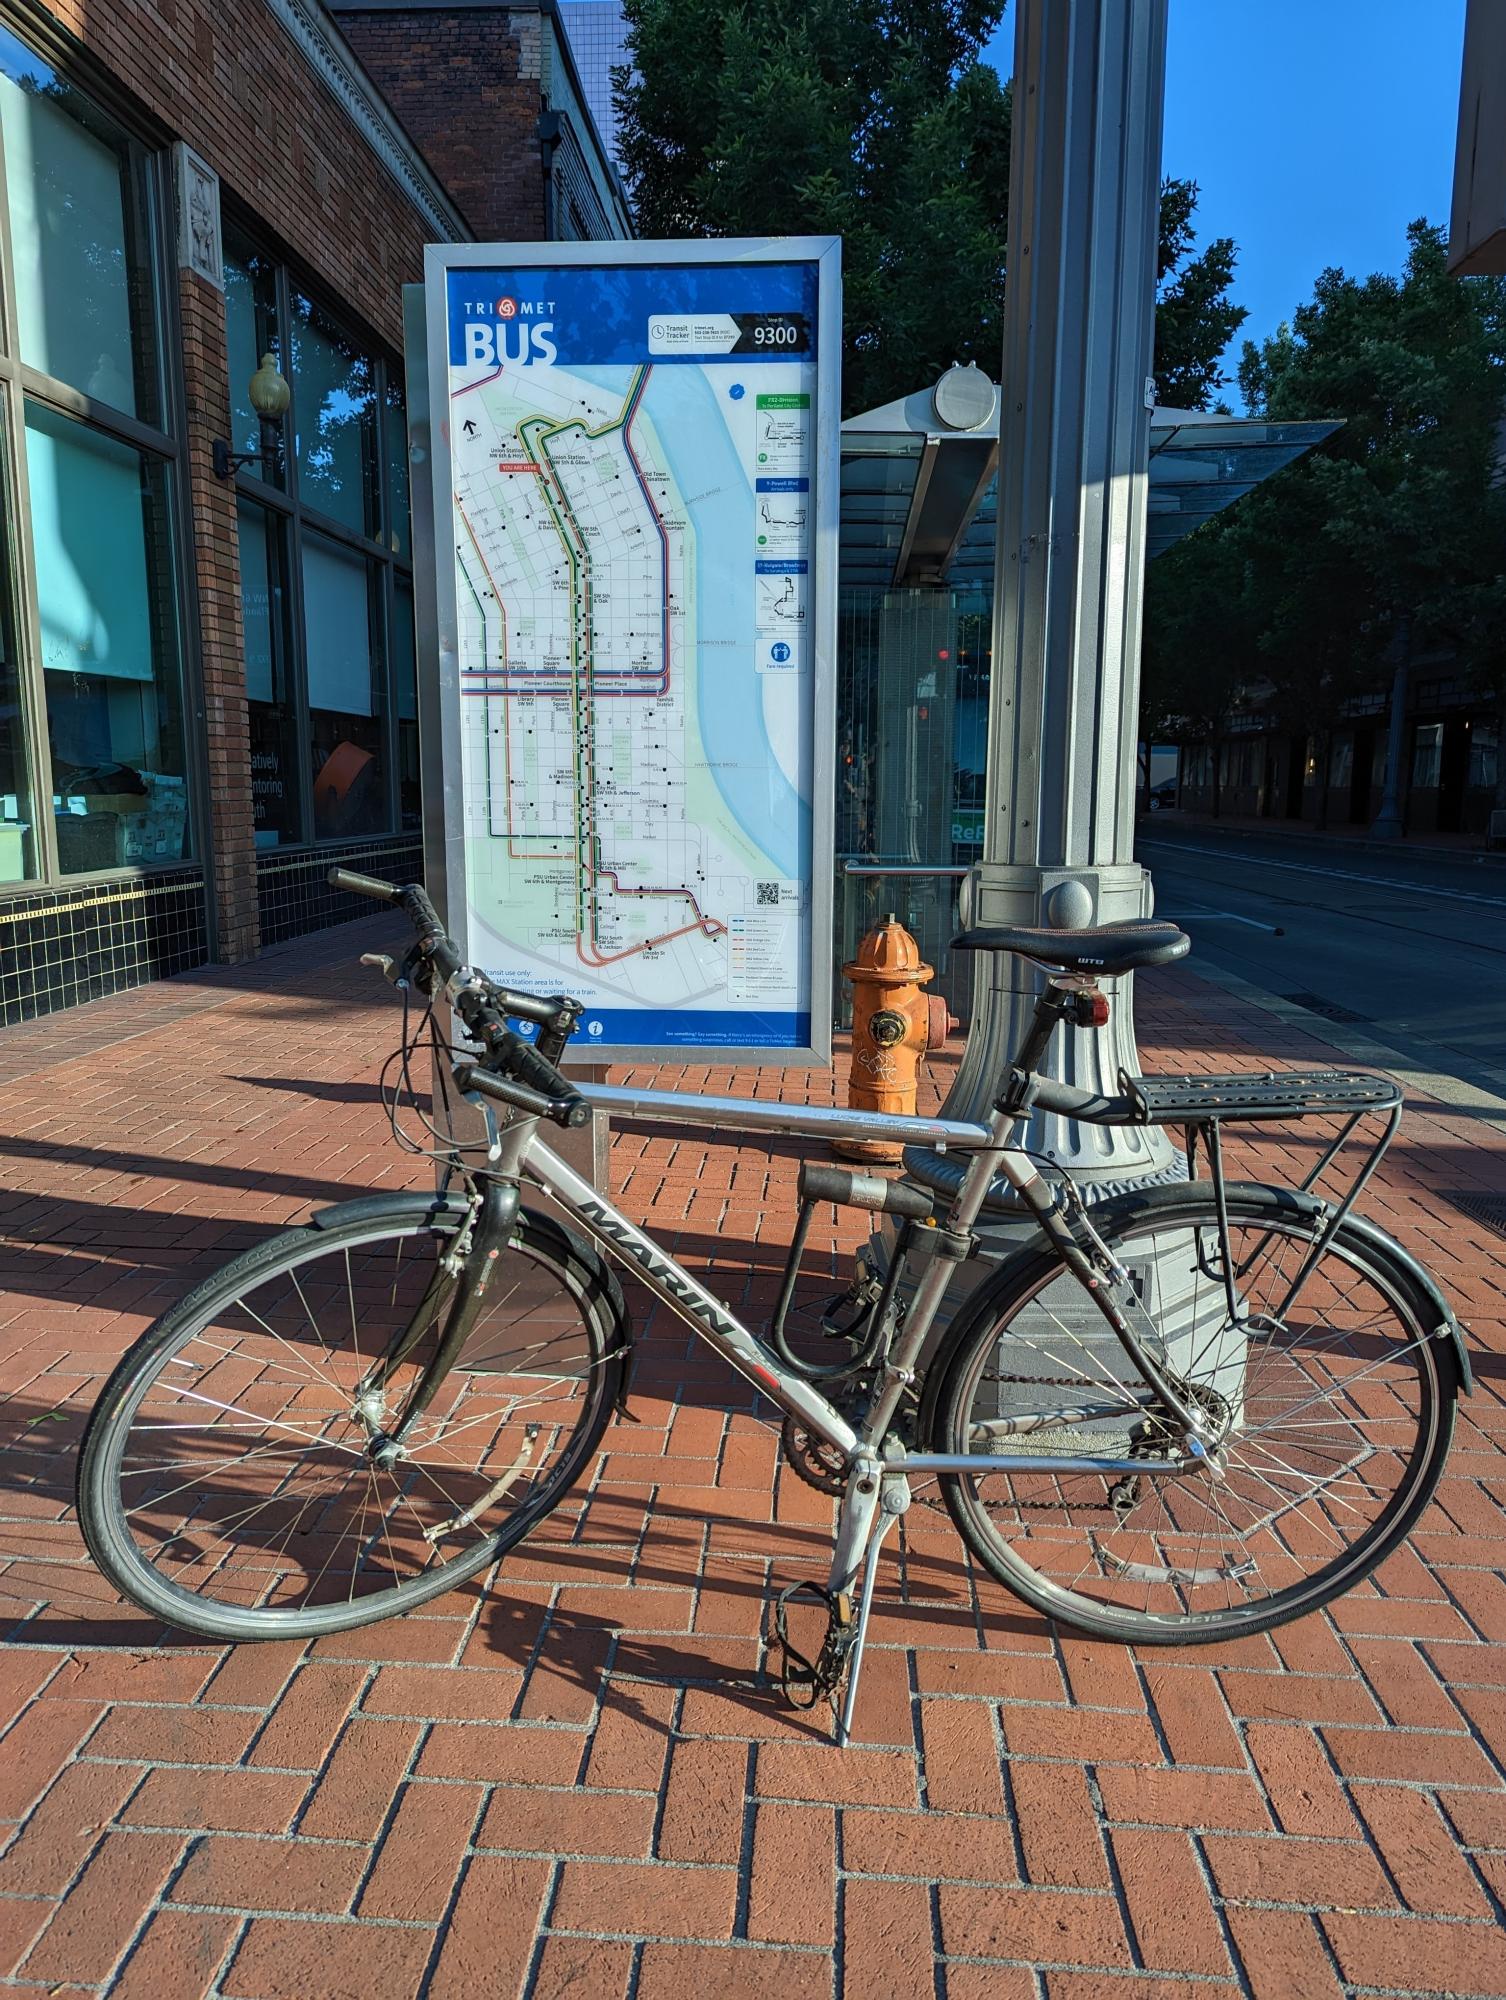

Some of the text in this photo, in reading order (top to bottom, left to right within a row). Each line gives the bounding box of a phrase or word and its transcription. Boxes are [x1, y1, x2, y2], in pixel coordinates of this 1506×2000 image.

[464, 303, 555, 314] TRI MET
[754, 327, 797, 344] 9300
[465, 323, 558, 366] BUS
[466, 433, 482, 442] NORTH
[577, 1201, 736, 1335] MARIN
